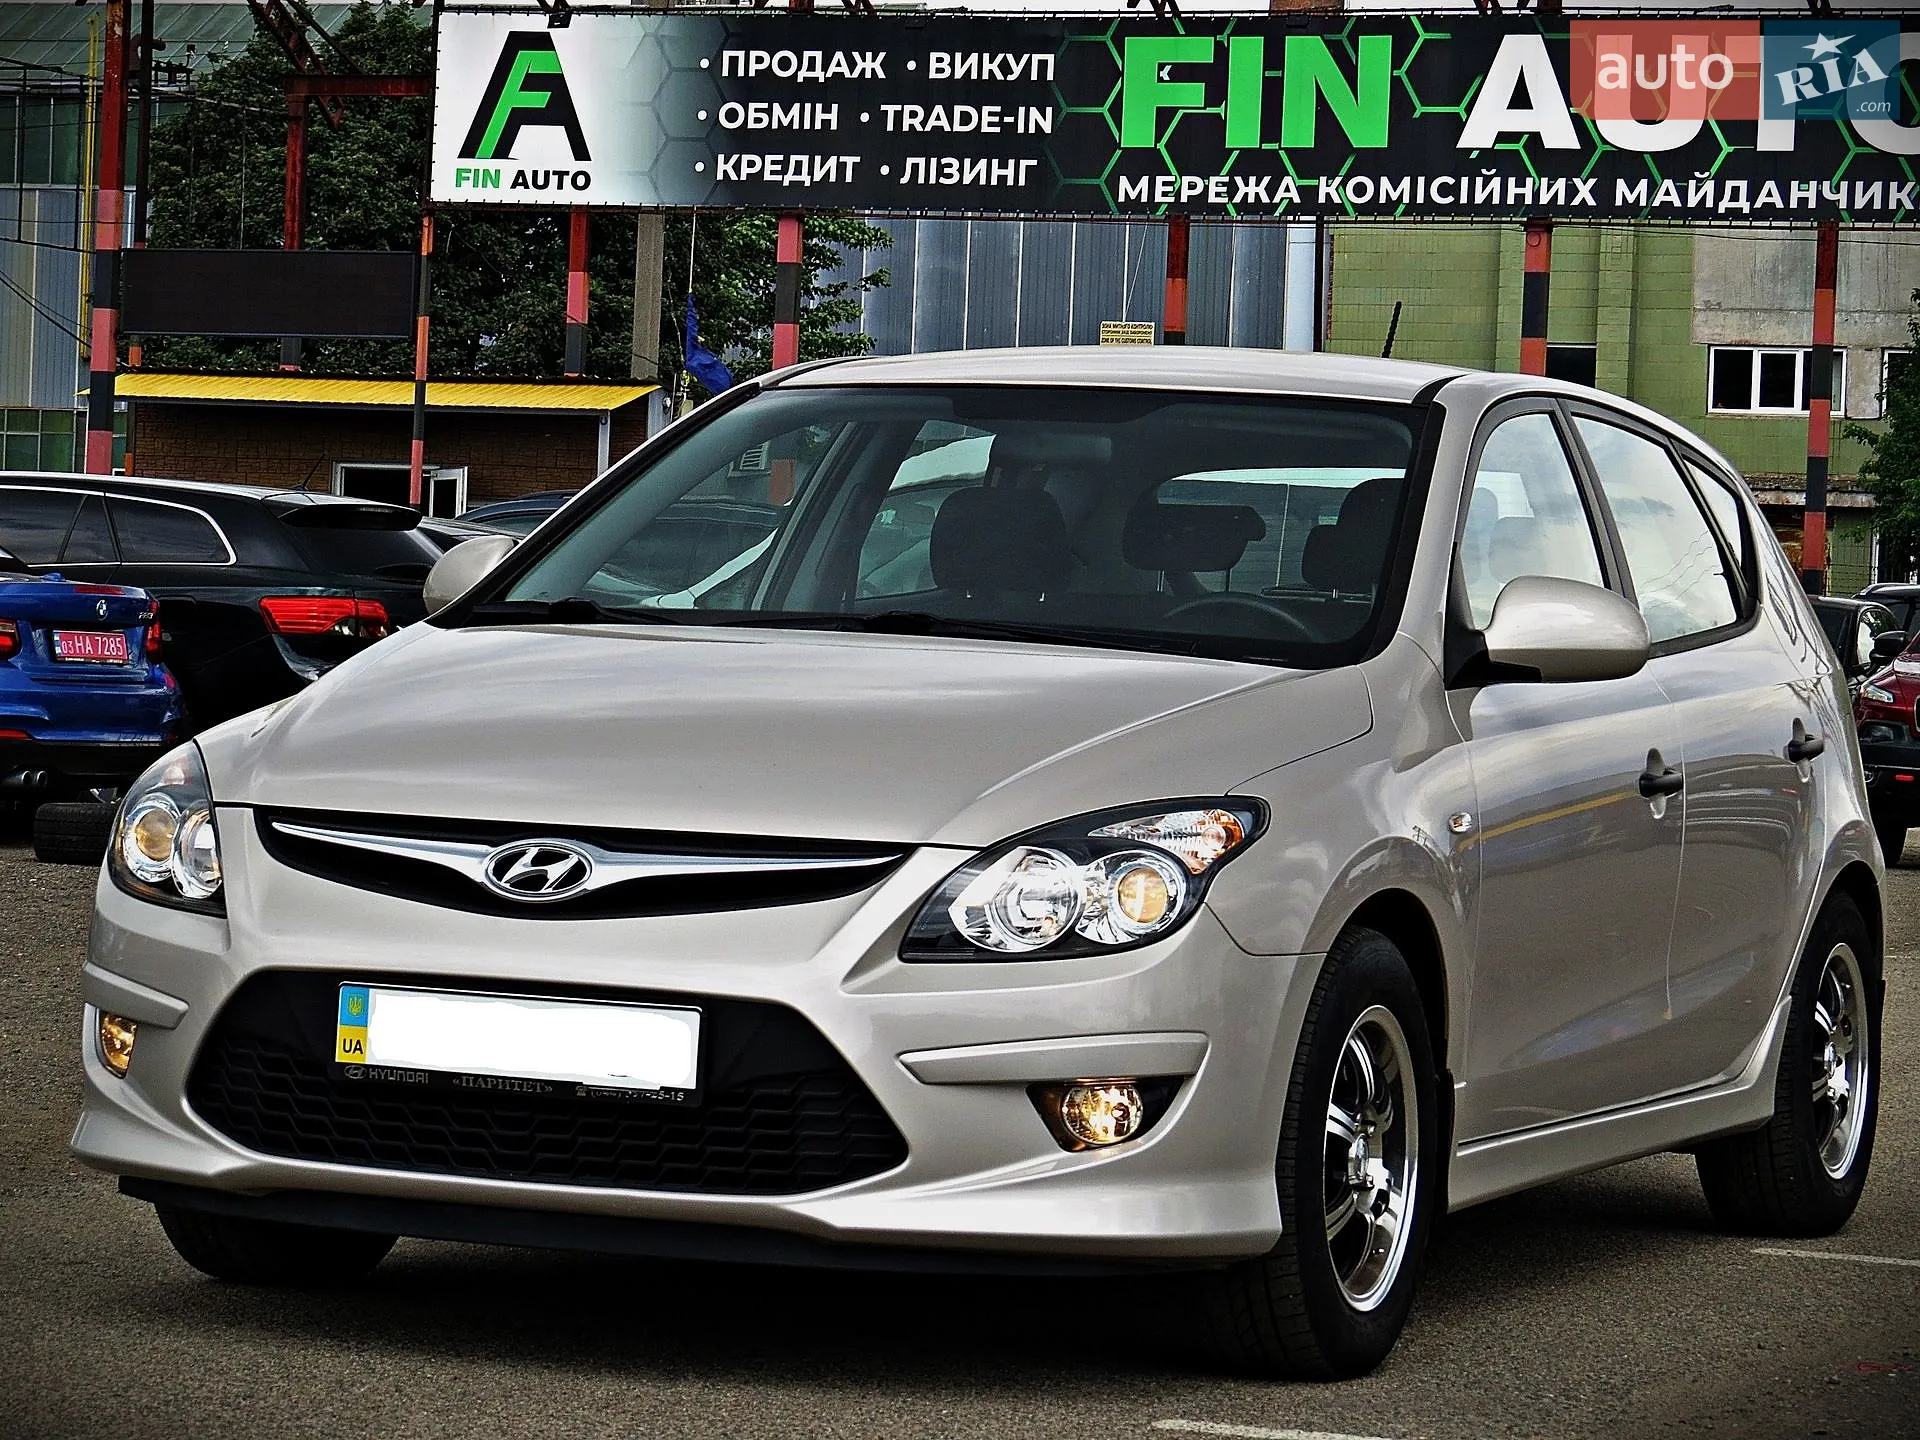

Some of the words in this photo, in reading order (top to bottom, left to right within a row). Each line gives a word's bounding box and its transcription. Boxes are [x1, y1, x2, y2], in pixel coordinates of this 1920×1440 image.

[721, 50, 886, 82] ПРОДАЖ
[928, 52, 1055, 81] ВИКУП
[1121, 36, 1392, 149] FIN
[718, 102, 838, 131] ОБМІН
[880, 105, 1053, 134] TRADE-IN
[455, 168, 501, 188] FIN
[510, 169, 592, 191] AUTO
[717, 154, 861, 186] КРЕДИТ
[900, 157, 1038, 187] ЛІЗИНГ
[1117, 174, 1301, 205] МЕРЕЖА
[1318, 169, 1597, 207] КОМІСІЙНИХ
[1615, 171, 1917, 213] МАЙДАНЧИК
[342, 1038, 364, 1056] UA
[369, 1067, 429, 1085] HYUNDAI
